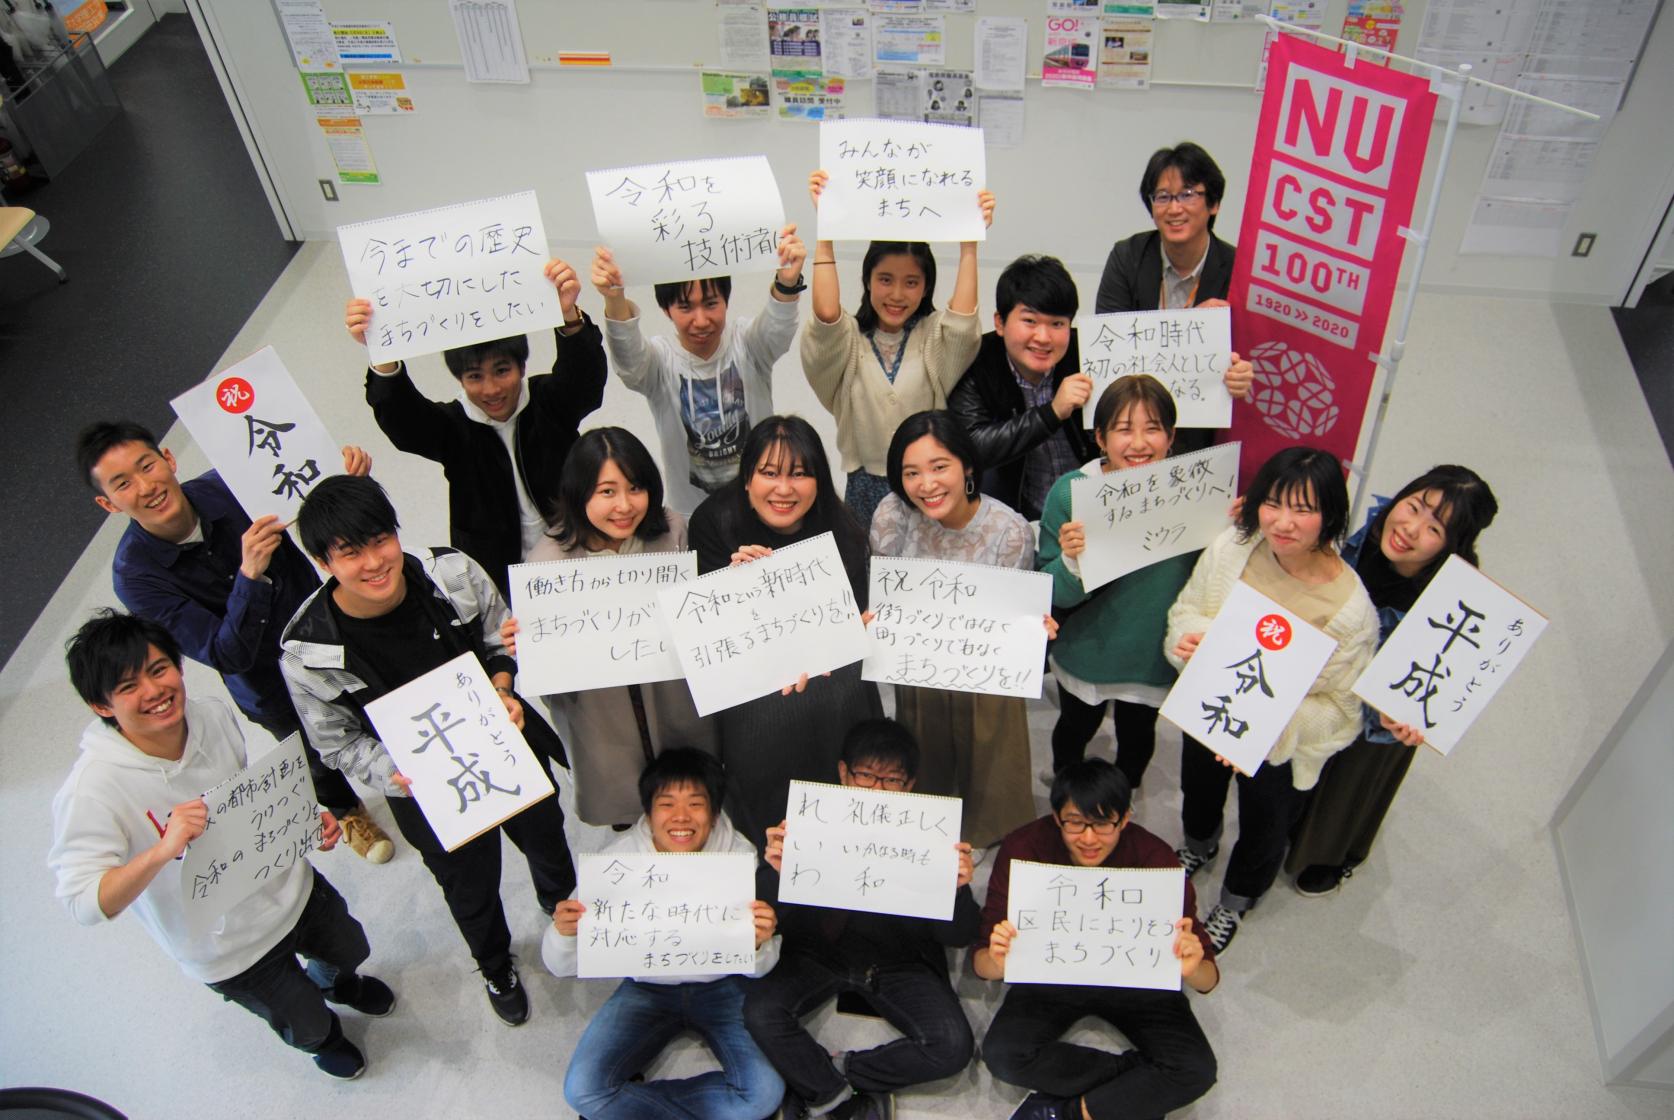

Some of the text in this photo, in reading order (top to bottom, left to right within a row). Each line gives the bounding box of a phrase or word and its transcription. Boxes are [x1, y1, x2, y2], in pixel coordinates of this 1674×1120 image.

[1048, 18, 1079, 32] GO!
[1284, 78, 1397, 174] NU
[839, 138, 932, 159] みんなが
[606, 170, 721, 206] 令和を
[856, 166, 973, 190] 笑顔になれる
[651, 201, 713, 242] 彩る
[878, 198, 942, 218] まちへ
[1272, 173, 1376, 247] CST
[361, 224, 541, 275] 今までの歴史
[1260, 242, 1360, 294] 100TH
[372, 270, 522, 308] を大切にした
[381, 302, 544, 347] まちづくりをしたい
[1090, 318, 1204, 352] 令和時代
[244, 414, 321, 501] 令和
[530, 602, 656, 643] まちづくりが
[1389, 599, 1486, 729] 平成
[1451, 618, 1524, 712] ありがとう
[1201, 648, 1275, 740] 令和
[456, 671, 516, 767] ありがとう
[410, 702, 521, 814] 平成
[592, 898, 742, 924] 新たな時代に
[1046, 873, 1143, 910] 令和
[589, 926, 683, 948] 対応する
[1018, 909, 1174, 939] 区民によりそう
[643, 952, 754, 969] まちづくりをしたい
[1045, 940, 1161, 968] まちづくり
